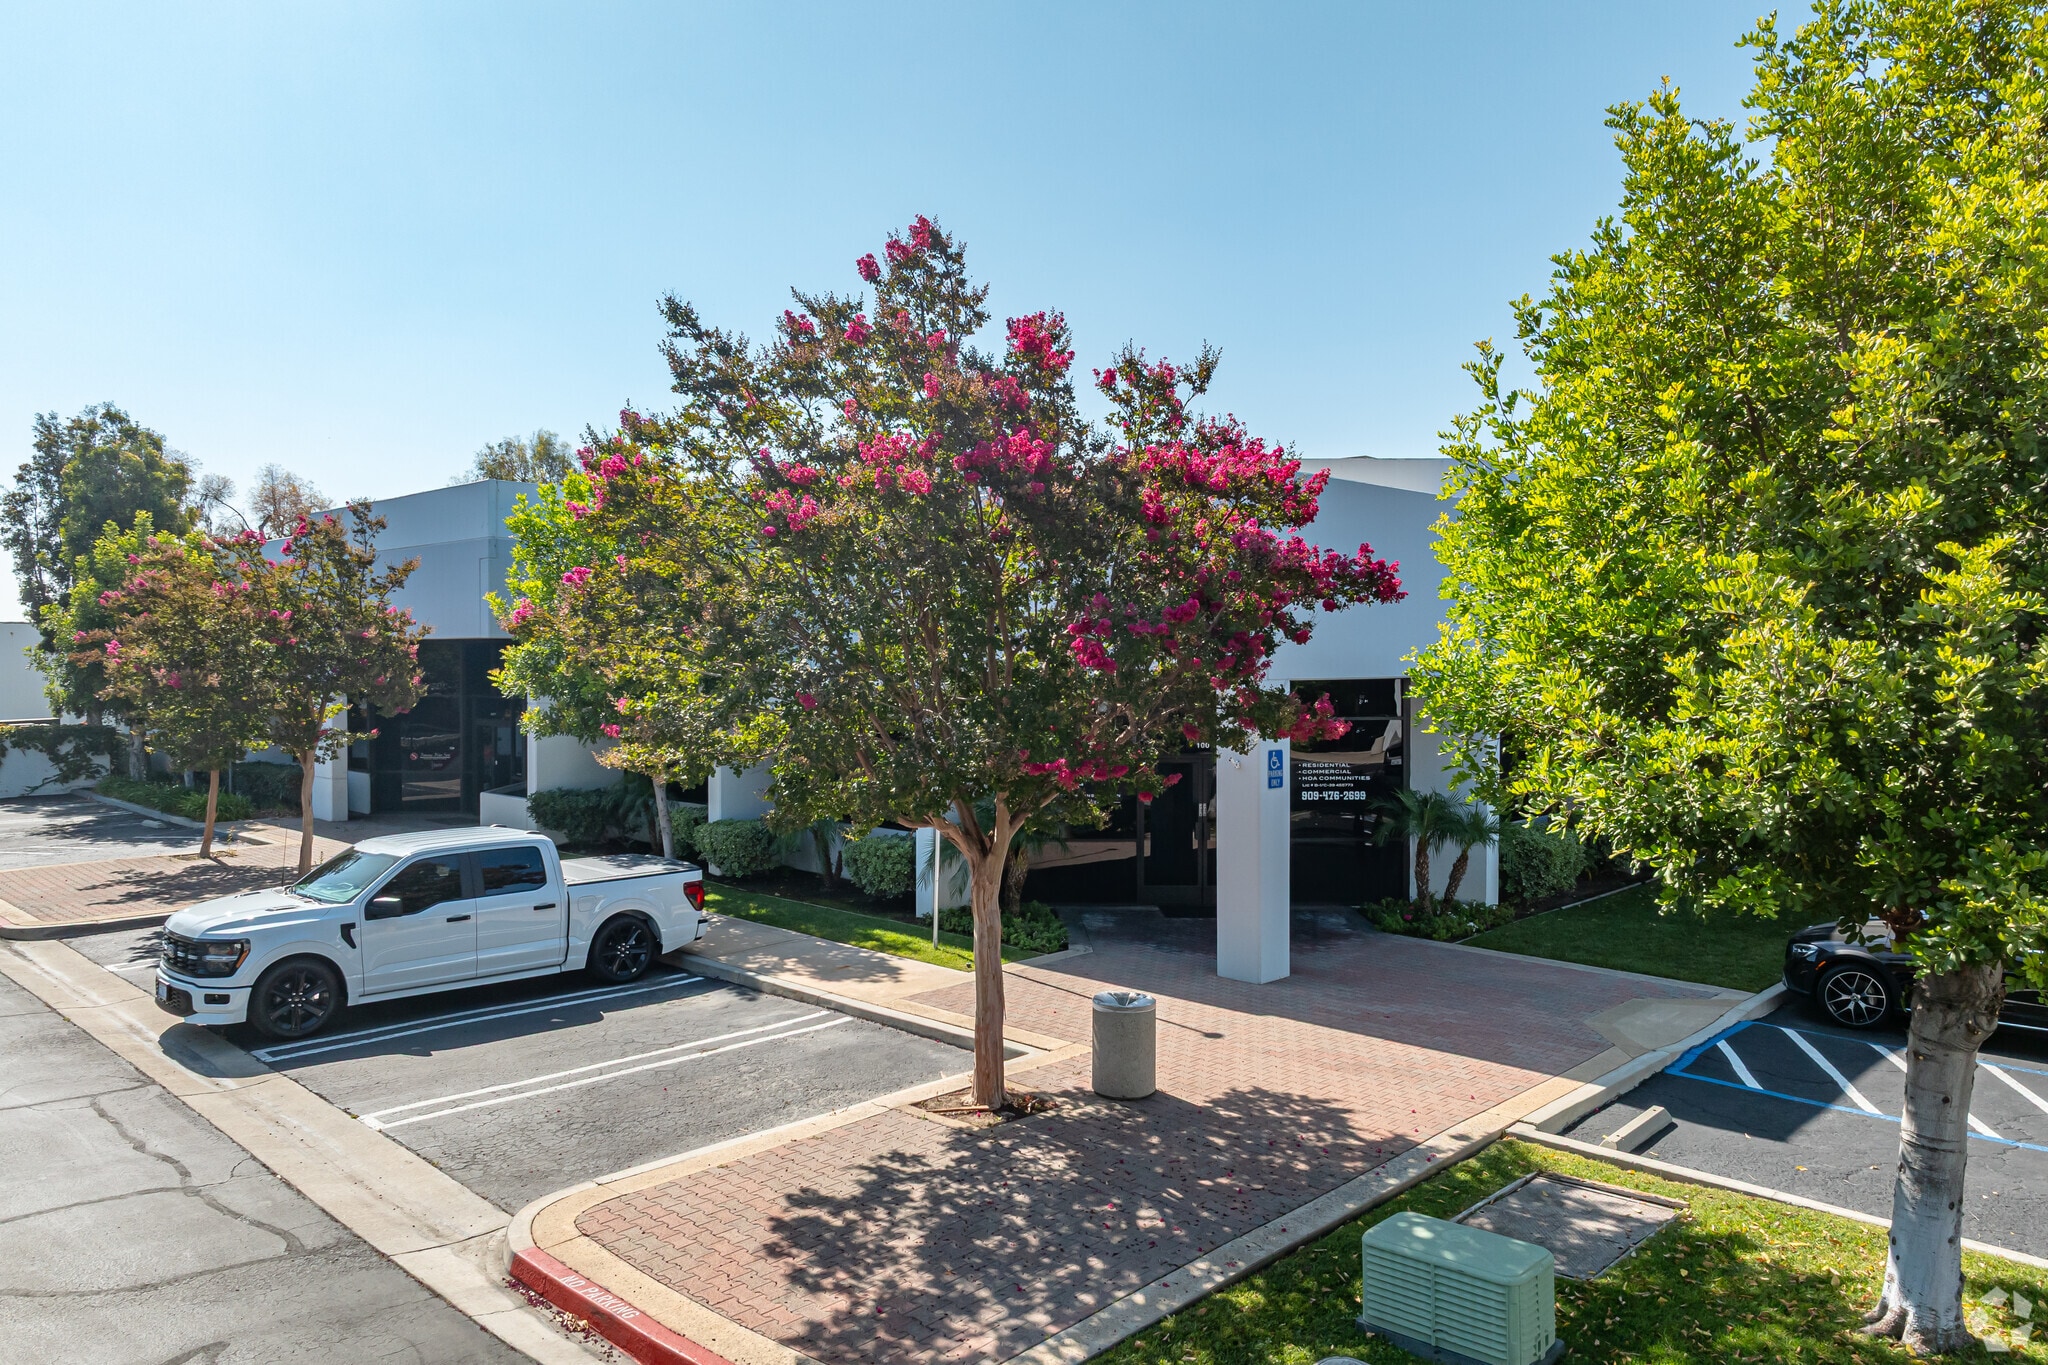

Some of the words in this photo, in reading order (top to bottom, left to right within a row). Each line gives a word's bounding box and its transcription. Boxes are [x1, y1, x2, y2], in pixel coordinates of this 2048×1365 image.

[1301, 790, 1367, 801] 909-476-2699
[560, 1275, 586, 1289] NO
[580, 1286, 640, 1319] PARKING
